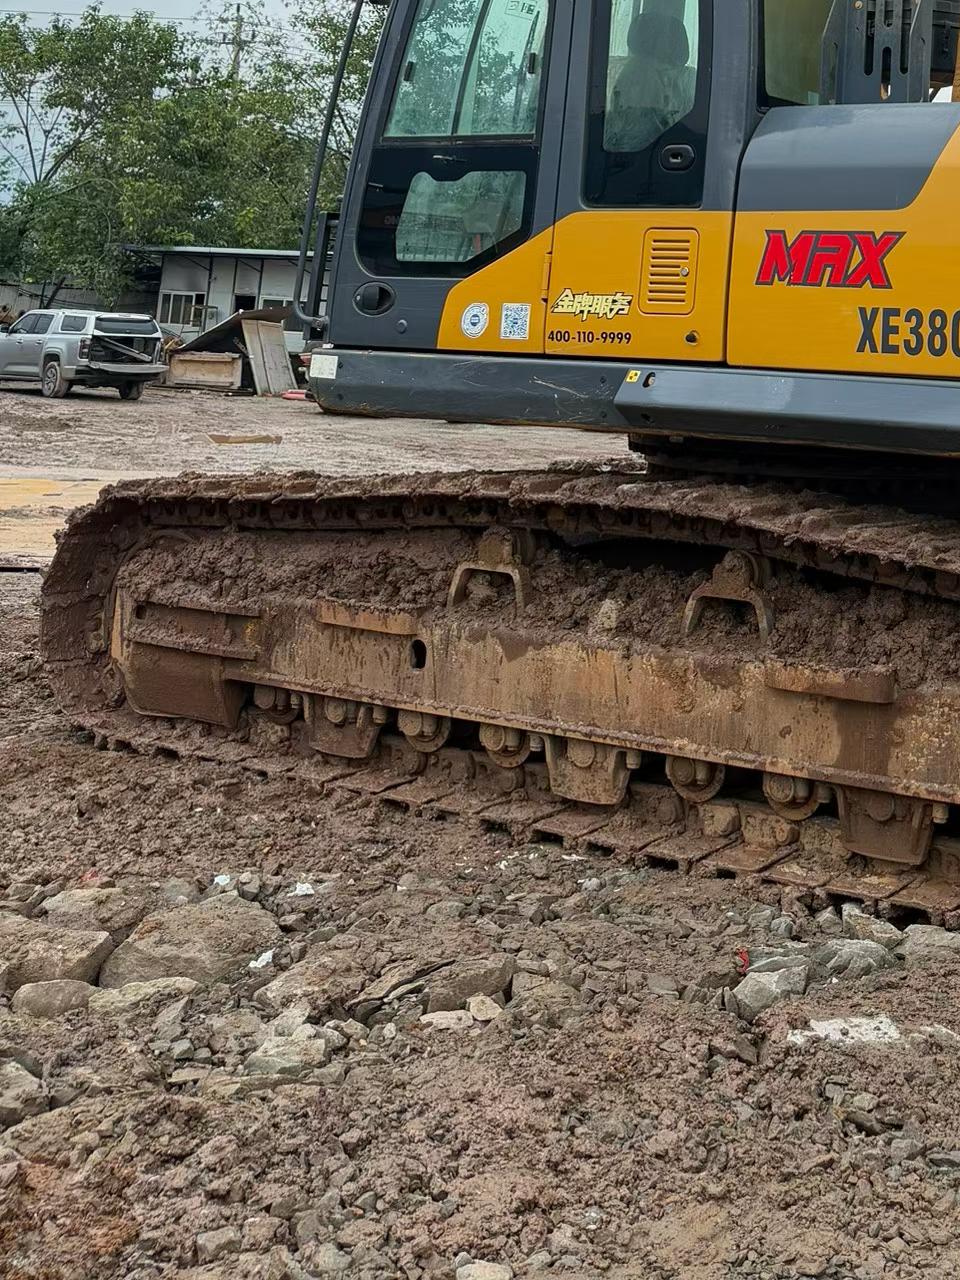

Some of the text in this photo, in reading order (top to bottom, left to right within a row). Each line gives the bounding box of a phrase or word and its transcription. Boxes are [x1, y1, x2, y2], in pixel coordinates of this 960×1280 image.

[755, 230, 907, 289] MAX
[551, 288, 633, 322] 金牌服务
[548, 330, 632, 345] 400-110-9999
